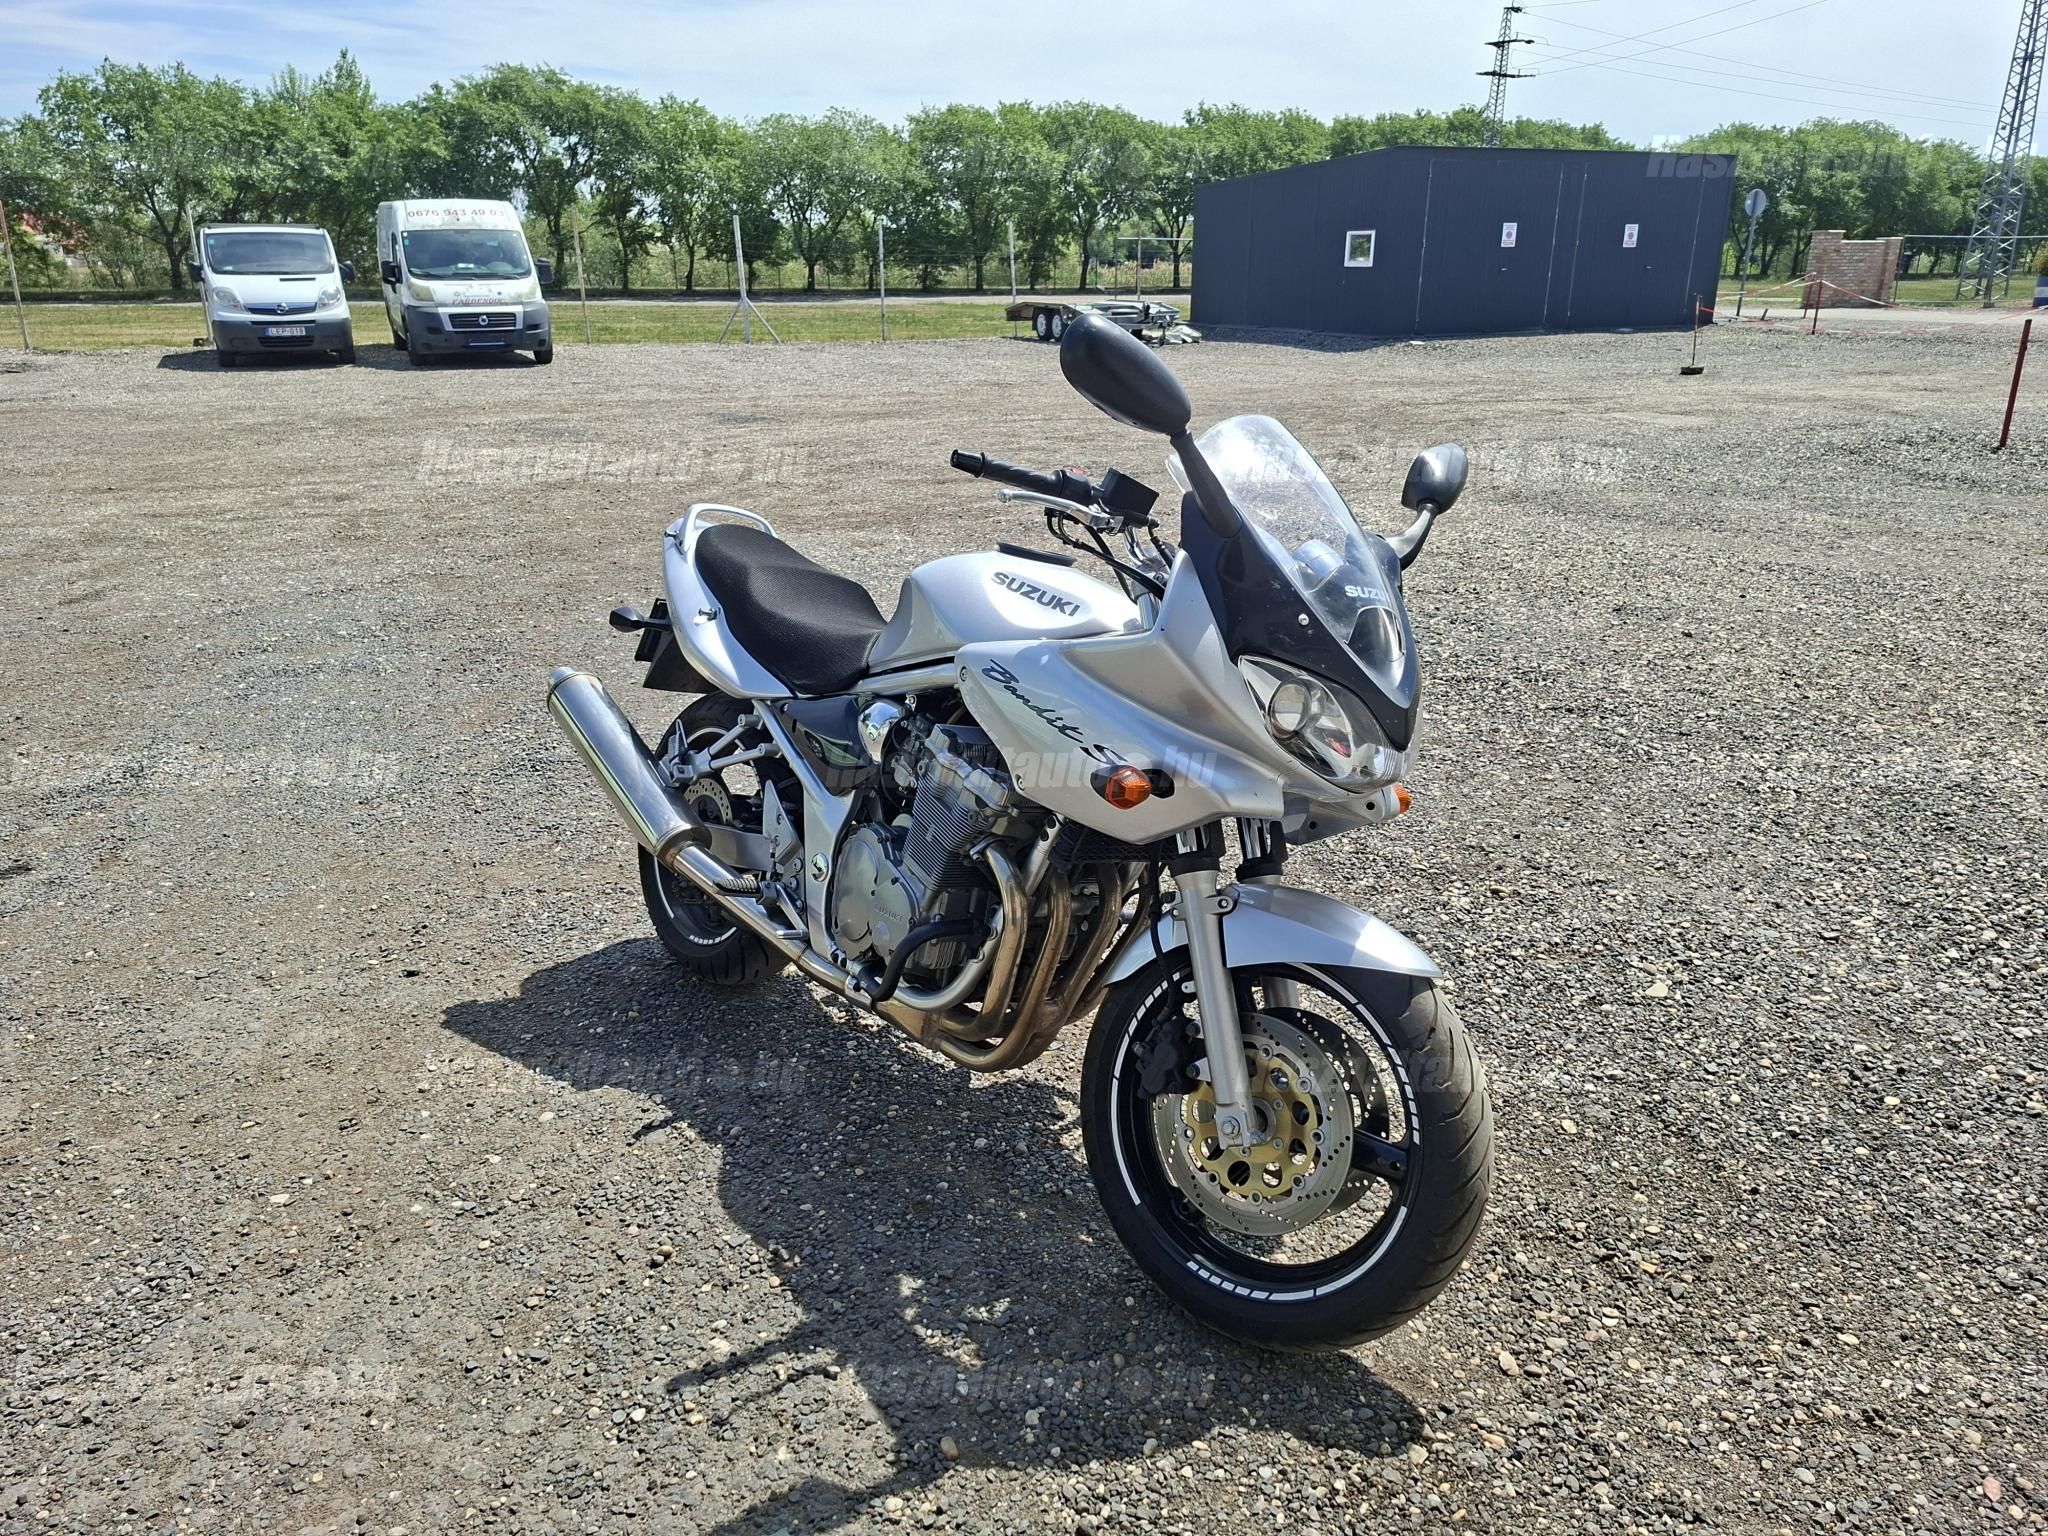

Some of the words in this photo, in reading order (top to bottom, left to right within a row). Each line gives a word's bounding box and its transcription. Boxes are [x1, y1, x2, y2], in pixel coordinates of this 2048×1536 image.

[443, 208, 466, 216] 943
[991, 571, 1080, 617] SUZUKI
[981, 658, 1084, 744] Bandit
[1079, 743, 1128, 767] S
